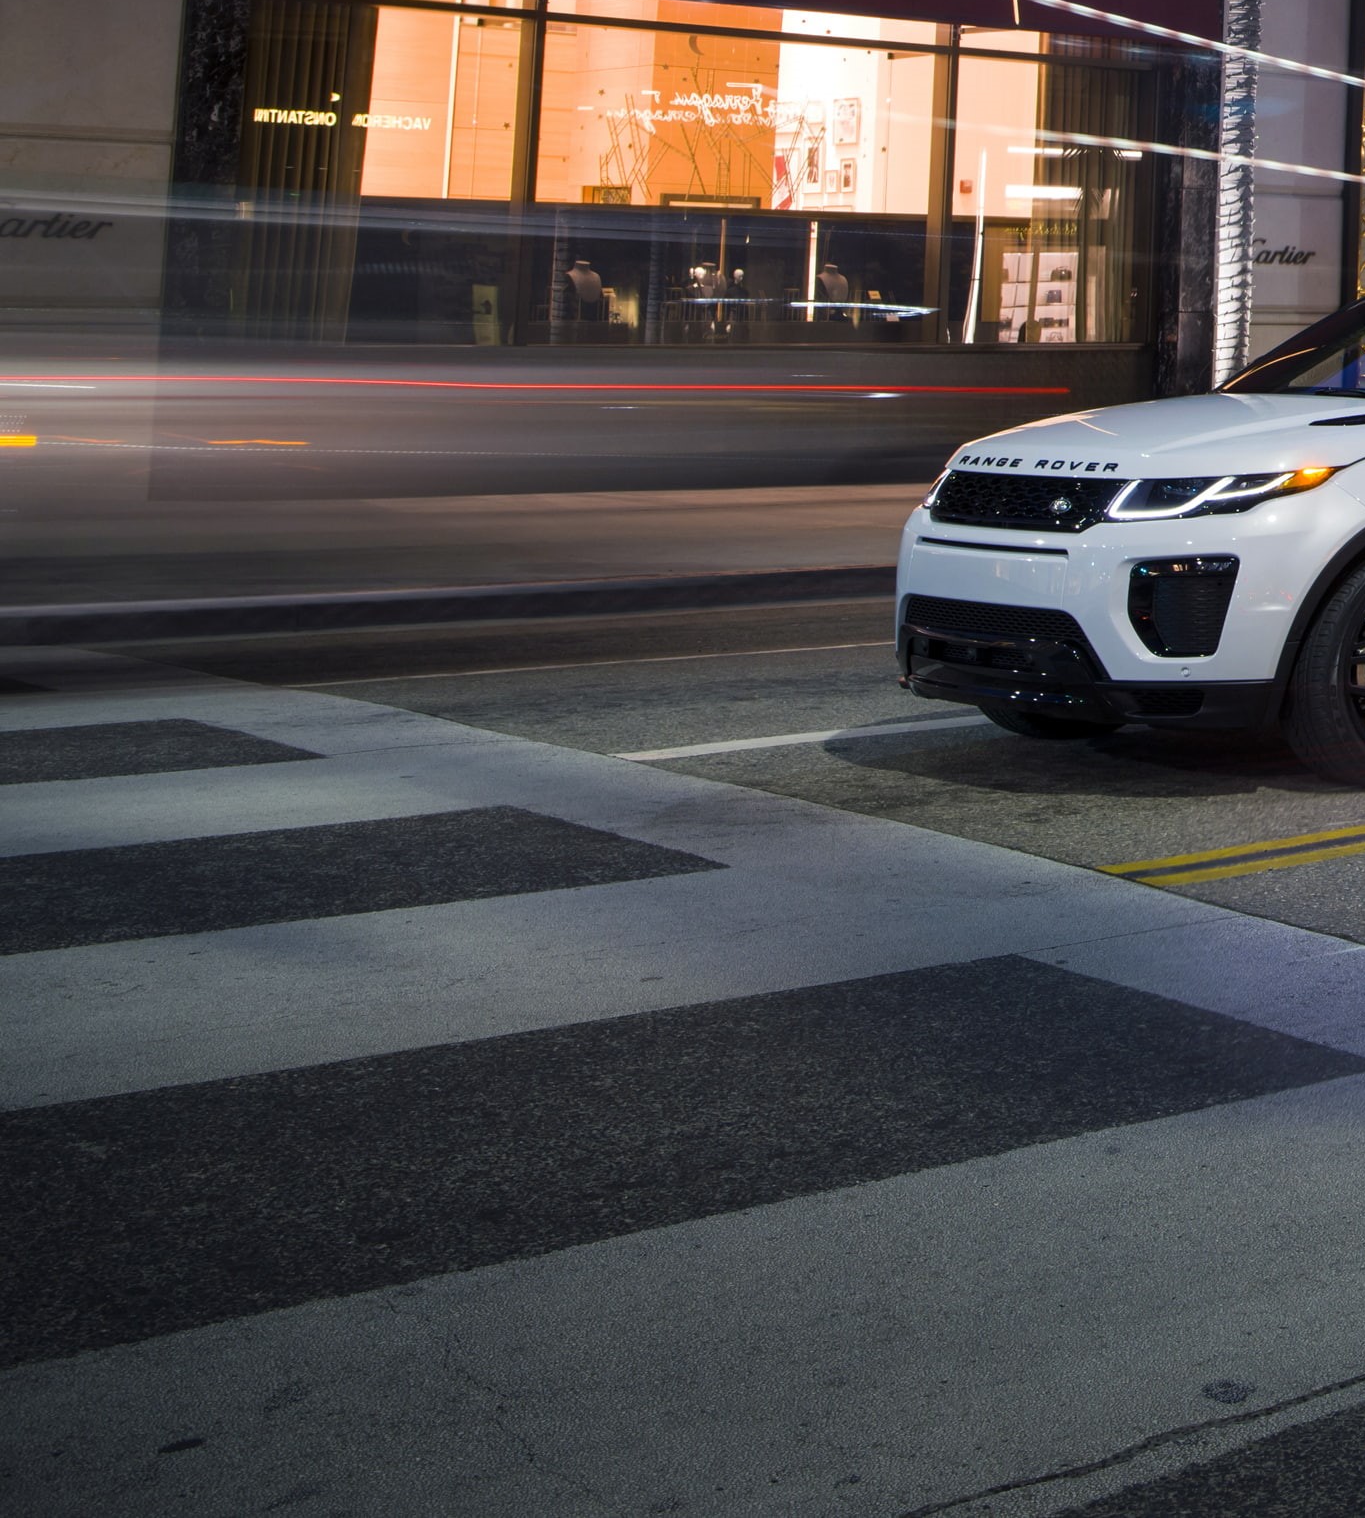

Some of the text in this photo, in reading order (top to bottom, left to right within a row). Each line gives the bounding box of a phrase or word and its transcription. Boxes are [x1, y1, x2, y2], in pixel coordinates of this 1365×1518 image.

[0, 213, 113, 239] artier
[959, 455, 1119, 472] RANGE ROVER
